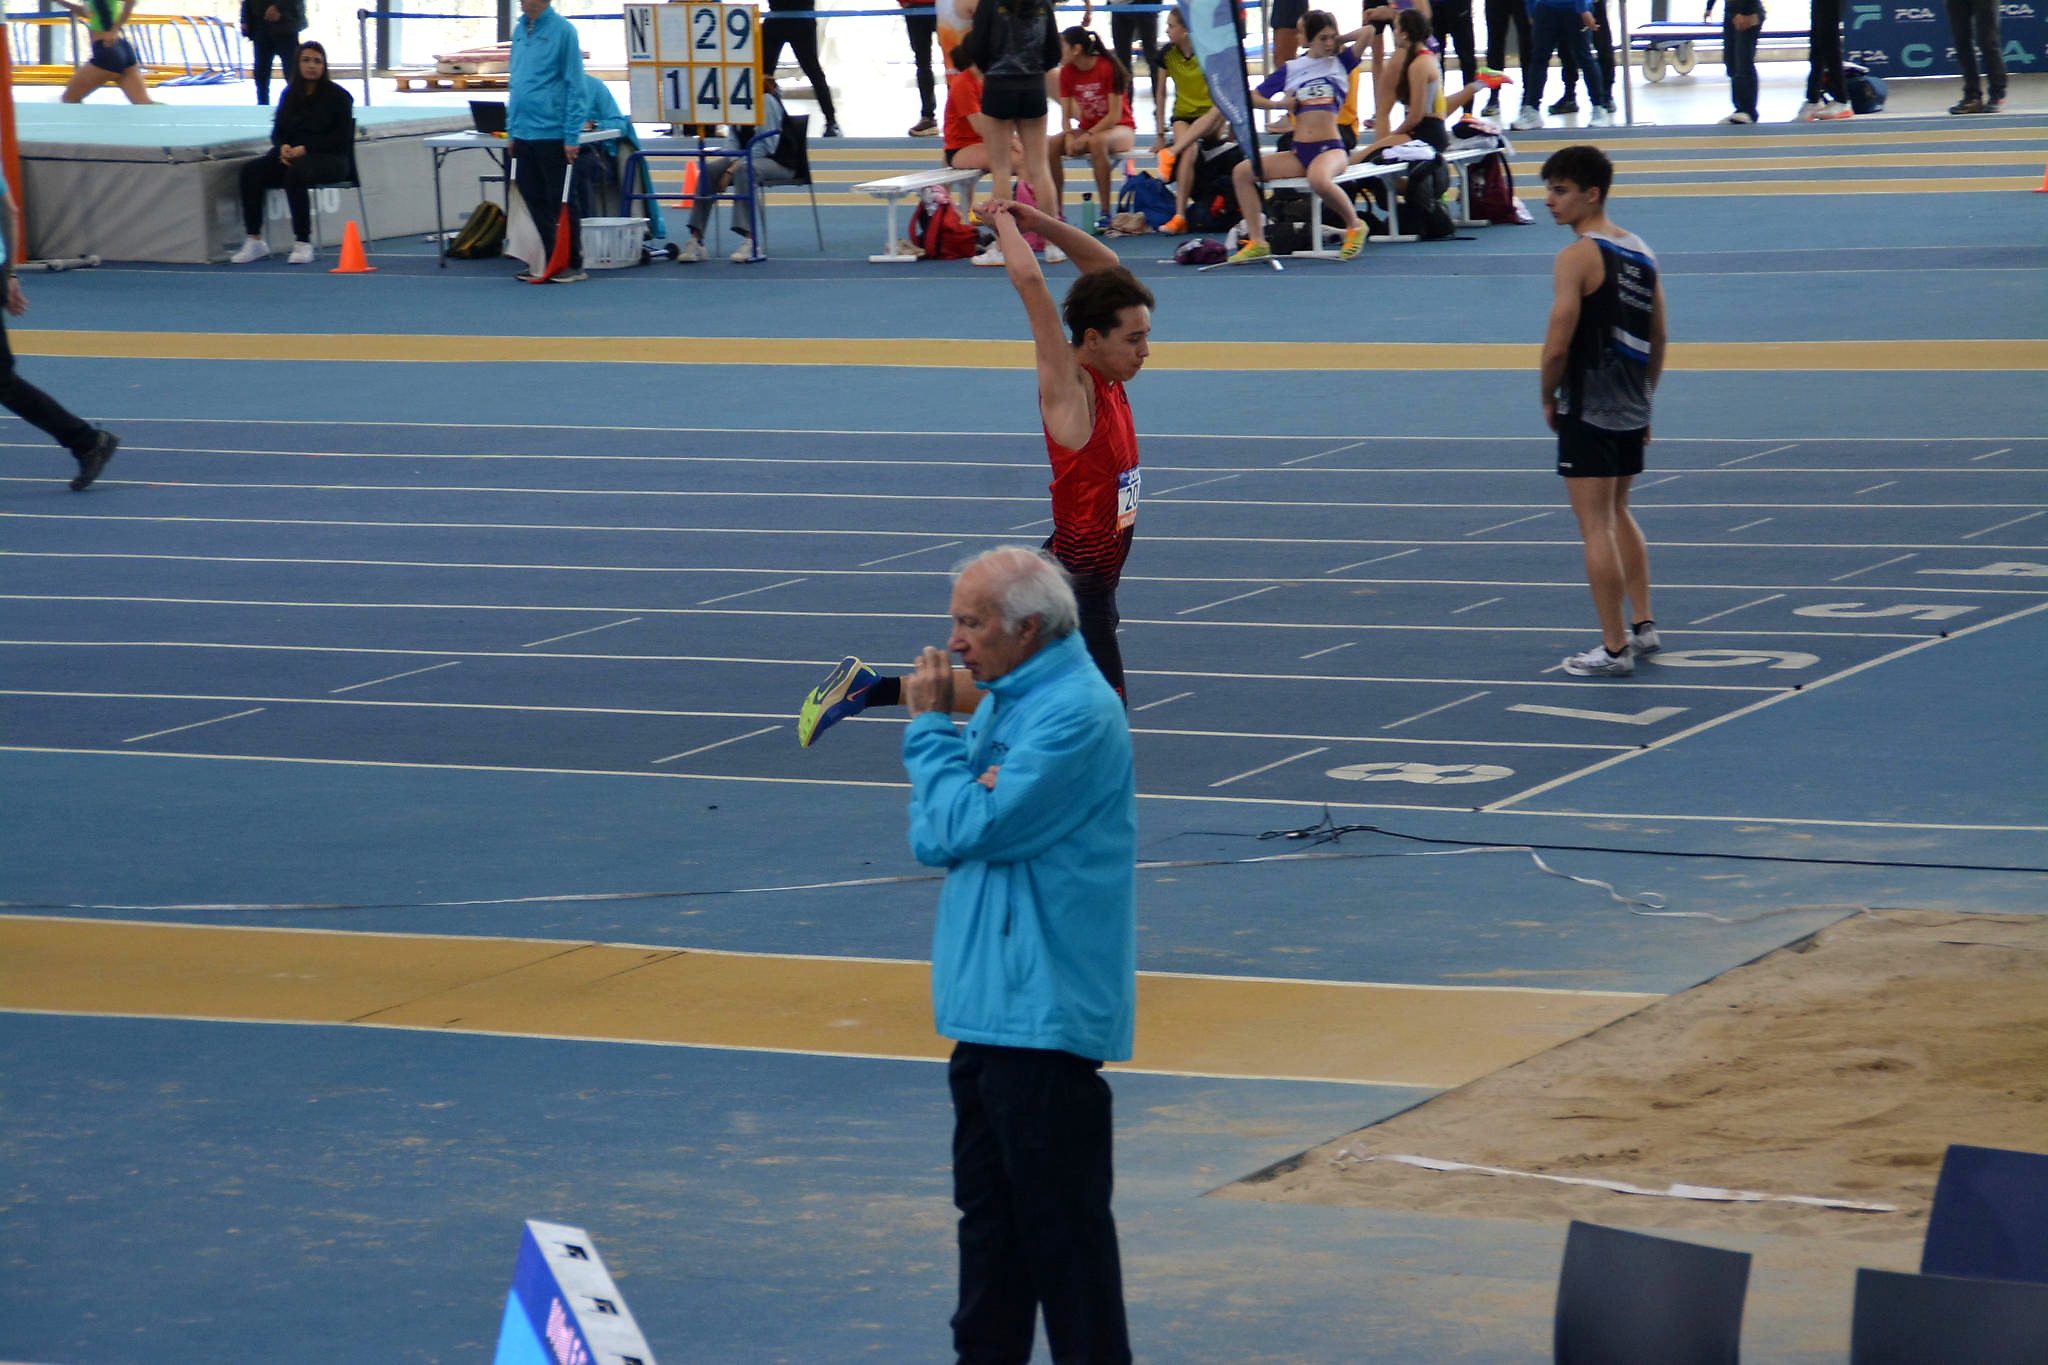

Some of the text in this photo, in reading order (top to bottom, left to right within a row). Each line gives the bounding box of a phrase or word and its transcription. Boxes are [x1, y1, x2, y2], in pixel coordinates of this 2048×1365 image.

[1895, 8, 1935, 19] FCA
[694, 8, 750, 50] 29
[1848, 50, 1888, 61] FCA
[1901, 43, 1933, 68] C
[666, 67, 753, 110] 144
[1125, 485, 1138, 511] 20
[1792, 603, 1982, 620] 5
[1649, 649, 1820, 669] 6
[1504, 703, 1691, 725] 7
[1325, 762, 1515, 784] 8
